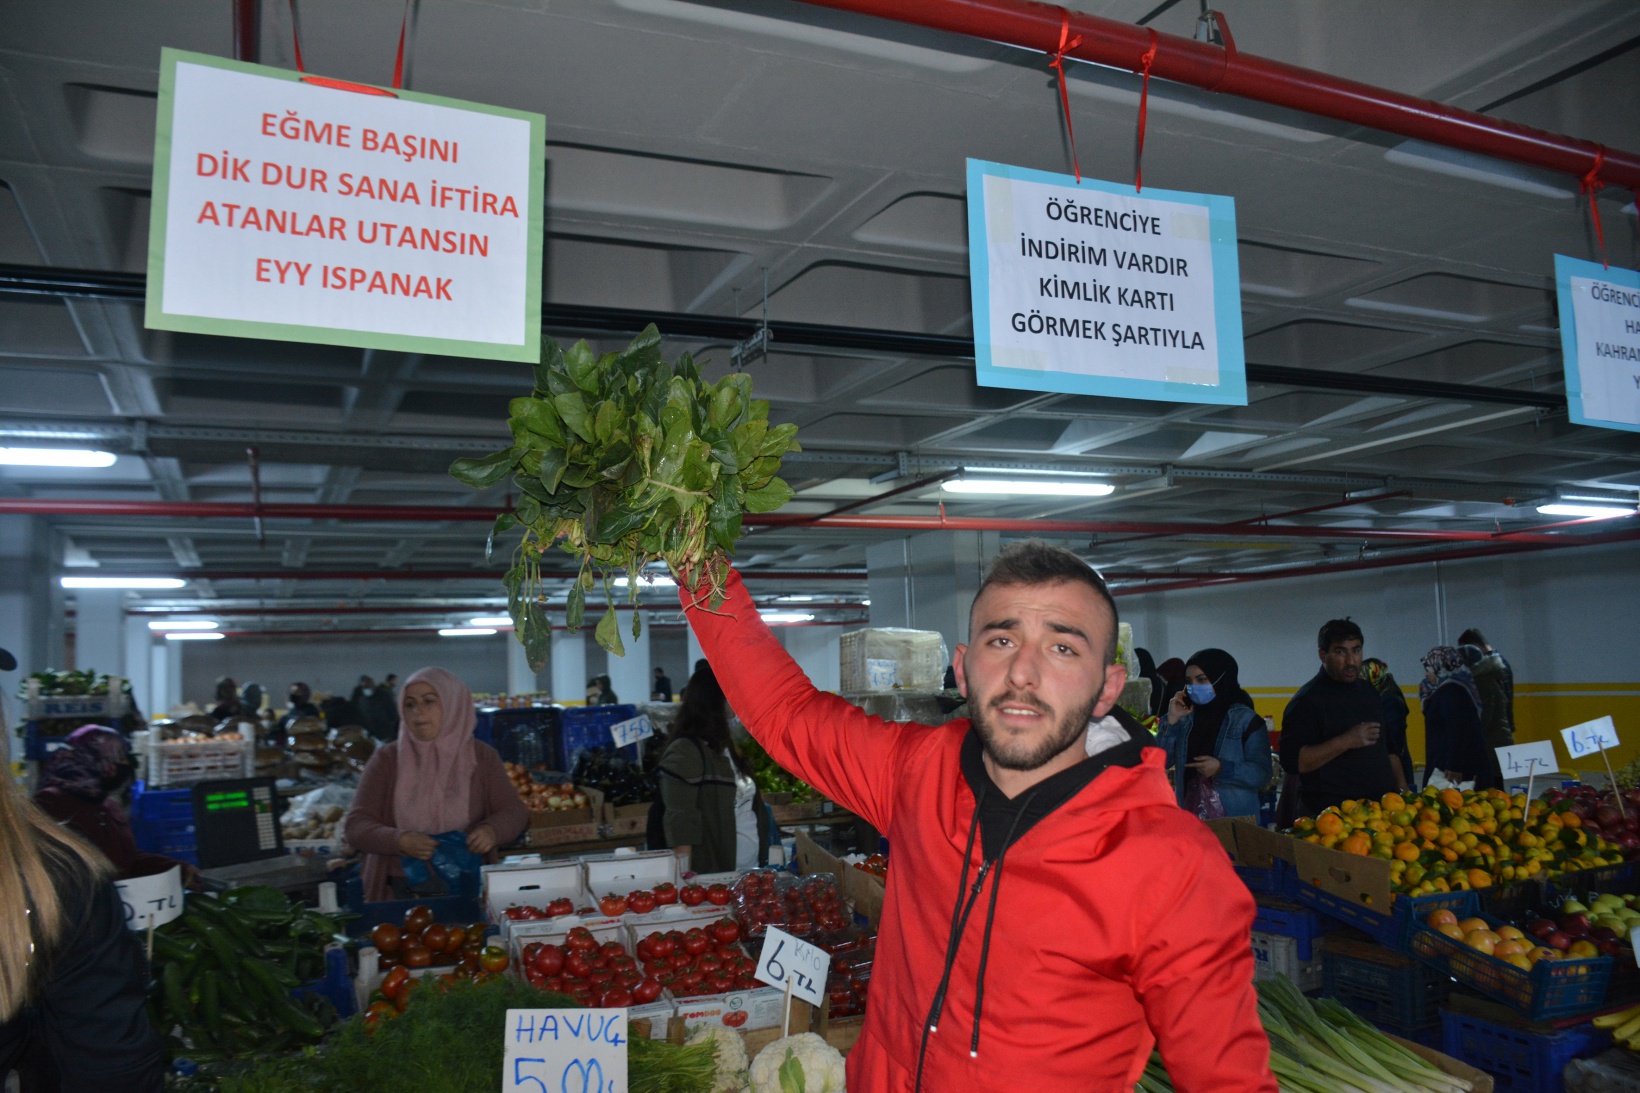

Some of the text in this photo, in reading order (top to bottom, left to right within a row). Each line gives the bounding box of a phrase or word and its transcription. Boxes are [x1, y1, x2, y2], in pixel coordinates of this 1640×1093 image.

[261, 109, 459, 163] EĞME BAŞINI
[196, 149, 519, 218] DİK DUR SANA İFTİRA
[197, 200, 489, 257] ATANLAR UTANSIN
[1046, 196, 1161, 236] ÖĞRENCİYE
[1020, 232, 1189, 277] İNDİRİM VARDIR
[255, 258, 453, 301] EYY ISPANAK
[1039, 274, 1175, 312] KİMLİK KARTI
[1011, 309, 1205, 351] GÖRMEK ŞARTIYLA
[515, 1013, 626, 1047] HAVUÇ
